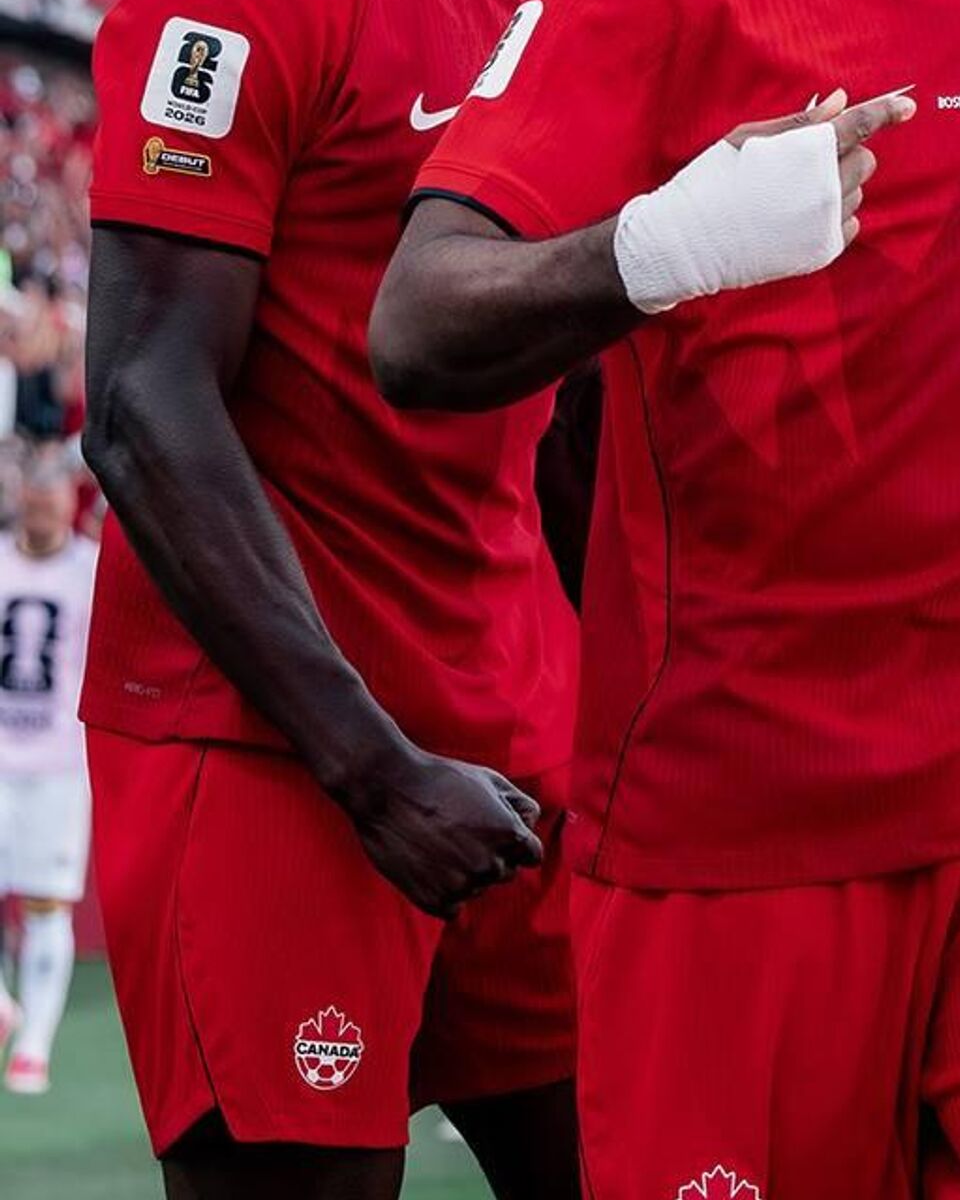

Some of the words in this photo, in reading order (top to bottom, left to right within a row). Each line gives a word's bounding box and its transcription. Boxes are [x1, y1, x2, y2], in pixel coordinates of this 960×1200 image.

[179, 85, 201, 99] FIFA
[164, 107, 206, 126] 2026
[160, 152, 206, 168] DEBUT
[296, 1042, 361, 1058] CANADA
